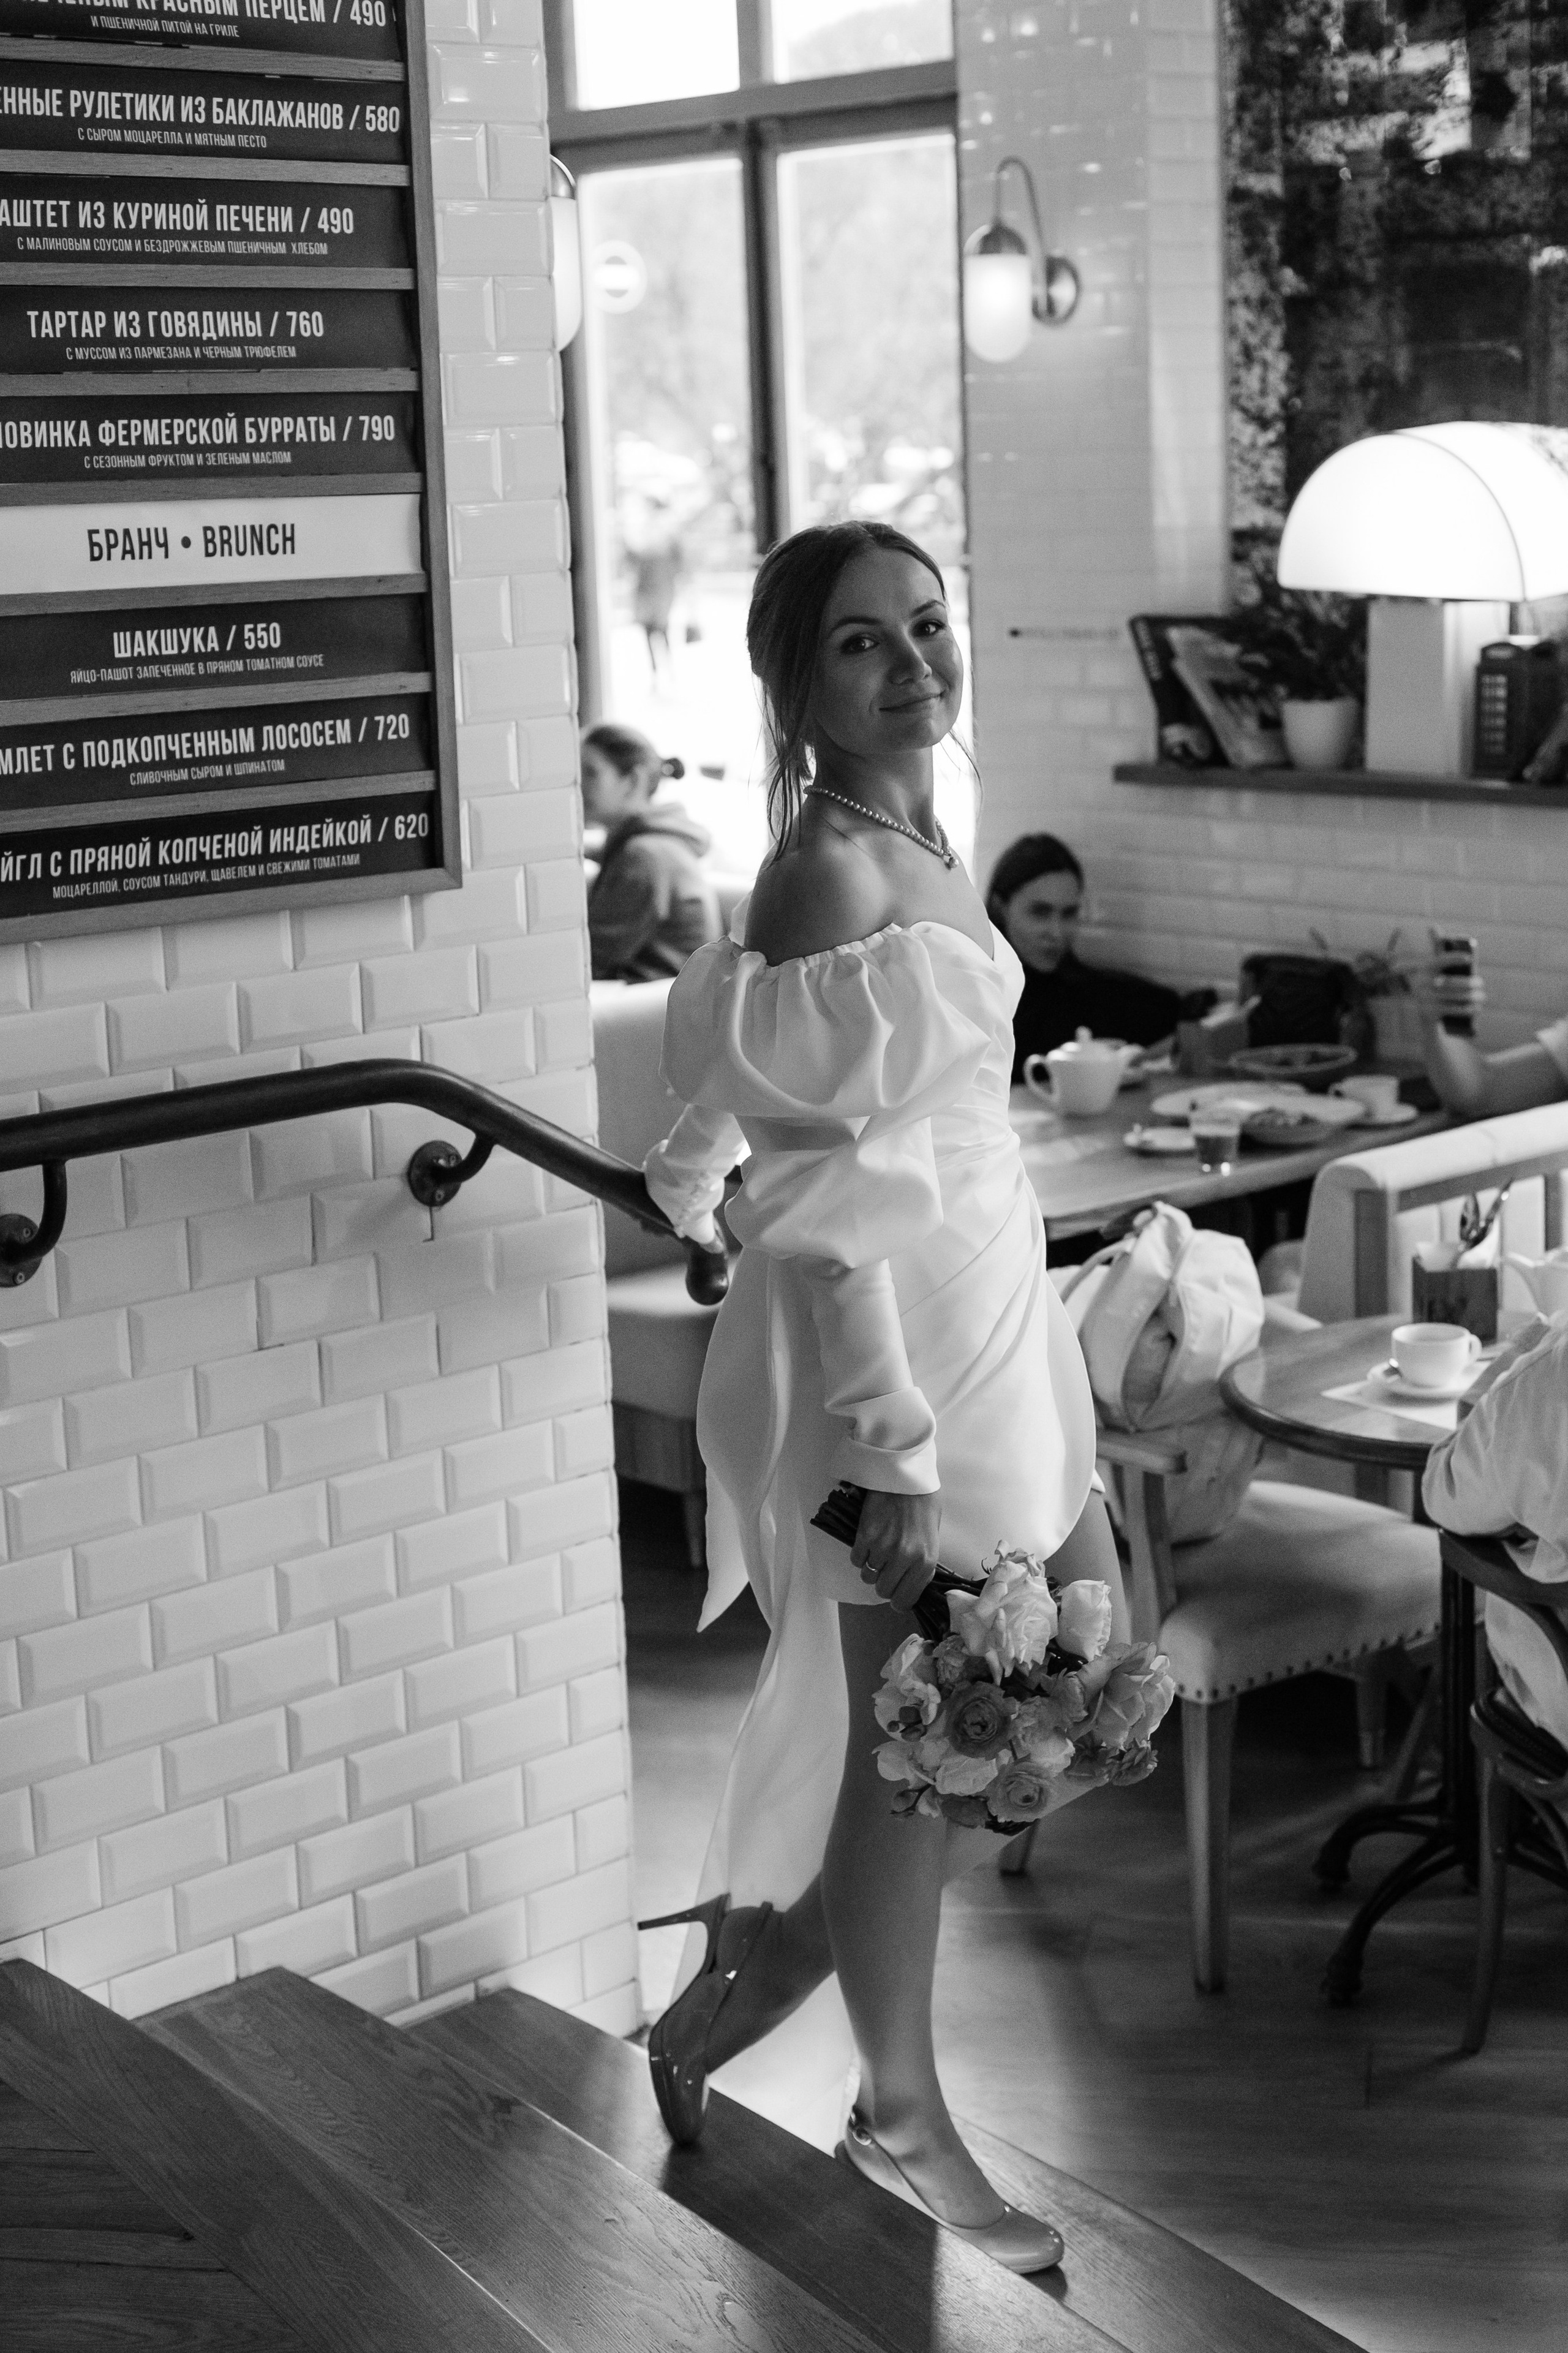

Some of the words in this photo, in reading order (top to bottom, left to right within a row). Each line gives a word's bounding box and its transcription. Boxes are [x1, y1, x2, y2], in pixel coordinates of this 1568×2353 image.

[90, 15, 99, 27] И
[99, 15, 160, 31] ПШЕНИЧНОЙ
[160, 20, 193, 34] ПИТОЙ
[194, 23, 208, 34] НА
[209, 23, 239, 37] ГРИЛЕ
[245, 0, 326, 24] ПЕРЦЕМ
[333, 0, 342, 23] /
[350, 0, 386, 27] 490
[70, 89, 175, 122] РУЛЕТИКИ
[181, 96, 206, 124] ИЗ
[212, 97, 344, 130] БАКЛАЖАНОВ
[349, 105, 360, 130] /
[365, 105, 400, 132] 580
[77, 127, 85, 140] С
[86, 127, 122, 142] СЫРОМ
[123, 129, 184, 144] МОЦАРЕЛЛА
[185, 132, 192, 145] И
[194, 132, 236, 146] МЯТНЫМ
[238, 134, 267, 148] ПЕСТО
[0, 198, 70, 228] АШТЕТ
[78, 201, 105, 229] ИЗ
[113, 198, 208, 231] КУРИНОЙ
[216, 205, 293, 233] ПЕЧЕНИ
[300, 207, 311, 233] /
[317, 207, 354, 234] 490
[17, 236, 24, 250] С
[26, 236, 91, 251] МАЛИНОВЫМ
[93, 238, 132, 252] СОУСОМ
[134, 239, 141, 252] И
[143, 239, 226, 254] БЕЗДРОЖЖЕВЫМ
[227, 240, 287, 254] ПШЕНИЧНЫМ
[291, 242, 328, 255] ХЛЕБОМ
[26, 311, 107, 338] ТАРТАР
[113, 311, 141, 338] ИЗ
[148, 311, 262, 341] ГОВЯДИНЫ
[270, 311, 279, 337] /
[286, 311, 324, 338] 760
[66, 347, 73, 360] С
[75, 347, 117, 360] МУССОМ
[118, 347, 132, 359] ИЗ
[134, 346, 192, 359] ПАРМЕЗАНА
[193, 346, 202, 358] И
[202, 346, 243, 358] ЧЕРНЫМ
[244, 346, 296, 358] ТРЮФЕЛЕМ
[98, 412, 238, 447] ФЕРМЕРСКОЙ
[244, 416, 336, 444] БУРРАТЫ
[342, 416, 352, 441] /
[359, 415, 395, 441] 790
[84, 456, 91, 469] С
[92, 455, 146, 469] СЕЗОННЫМ
[148, 453, 195, 467] ФРУКТОМ
[196, 453, 203, 466] И
[205, 452, 251, 466] ЗЕЛЕНЫМ
[252, 451, 292, 464] МАСЛОМ
[87, 527, 169, 562] БРАНЧ
[202, 523, 295, 557] BRUNCH
[113, 626, 219, 658] ШАКШУКА
[226, 625, 236, 651] /
[244, 622, 281, 650] 550
[70, 667, 133, 684] ЯЙЦО-ПАШОТ
[136, 662, 196, 679] ЗАПЕЧЕННОЕ
[198, 662, 205, 674] В
[206, 659, 244, 674] ПРЯНОМ
[246, 656, 295, 671] ТОМАТНОМ
[296, 654, 324, 668] СОУСЕ
[62, 742, 75, 769] С
[83, 728, 255, 768] ПОДКОПЧЕННЫМ
[262, 719, 352, 751] ЛОСОСЕМ
[358, 717, 368, 742] /
[374, 713, 410, 741] 720
[129, 768, 189, 785] СЛИВОЧНЫМ
[190, 765, 224, 780] СЫРОМ
[225, 764, 232, 776] И
[233, 759, 285, 776] ШПИНАТОМ
[1, 851, 42, 882] ЙГЛ
[50, 851, 62, 877] С
[70, 837, 151, 875] ПРЯНОЙ
[159, 825, 262, 865] КОПЧЕНОЙ
[270, 814, 371, 854] ИНДЕЙКОЙ
[378, 817, 388, 842] /
[394, 813, 428, 840] 620
[123, 875, 161, 891] СОУСОМ
[211, 864, 257, 882] ЩАВЕЛЕМ
[258, 864, 265, 876] И
[266, 859, 310, 875] СВЕЖИМИ
[312, 853, 360, 869] ТОМАТАМИ
